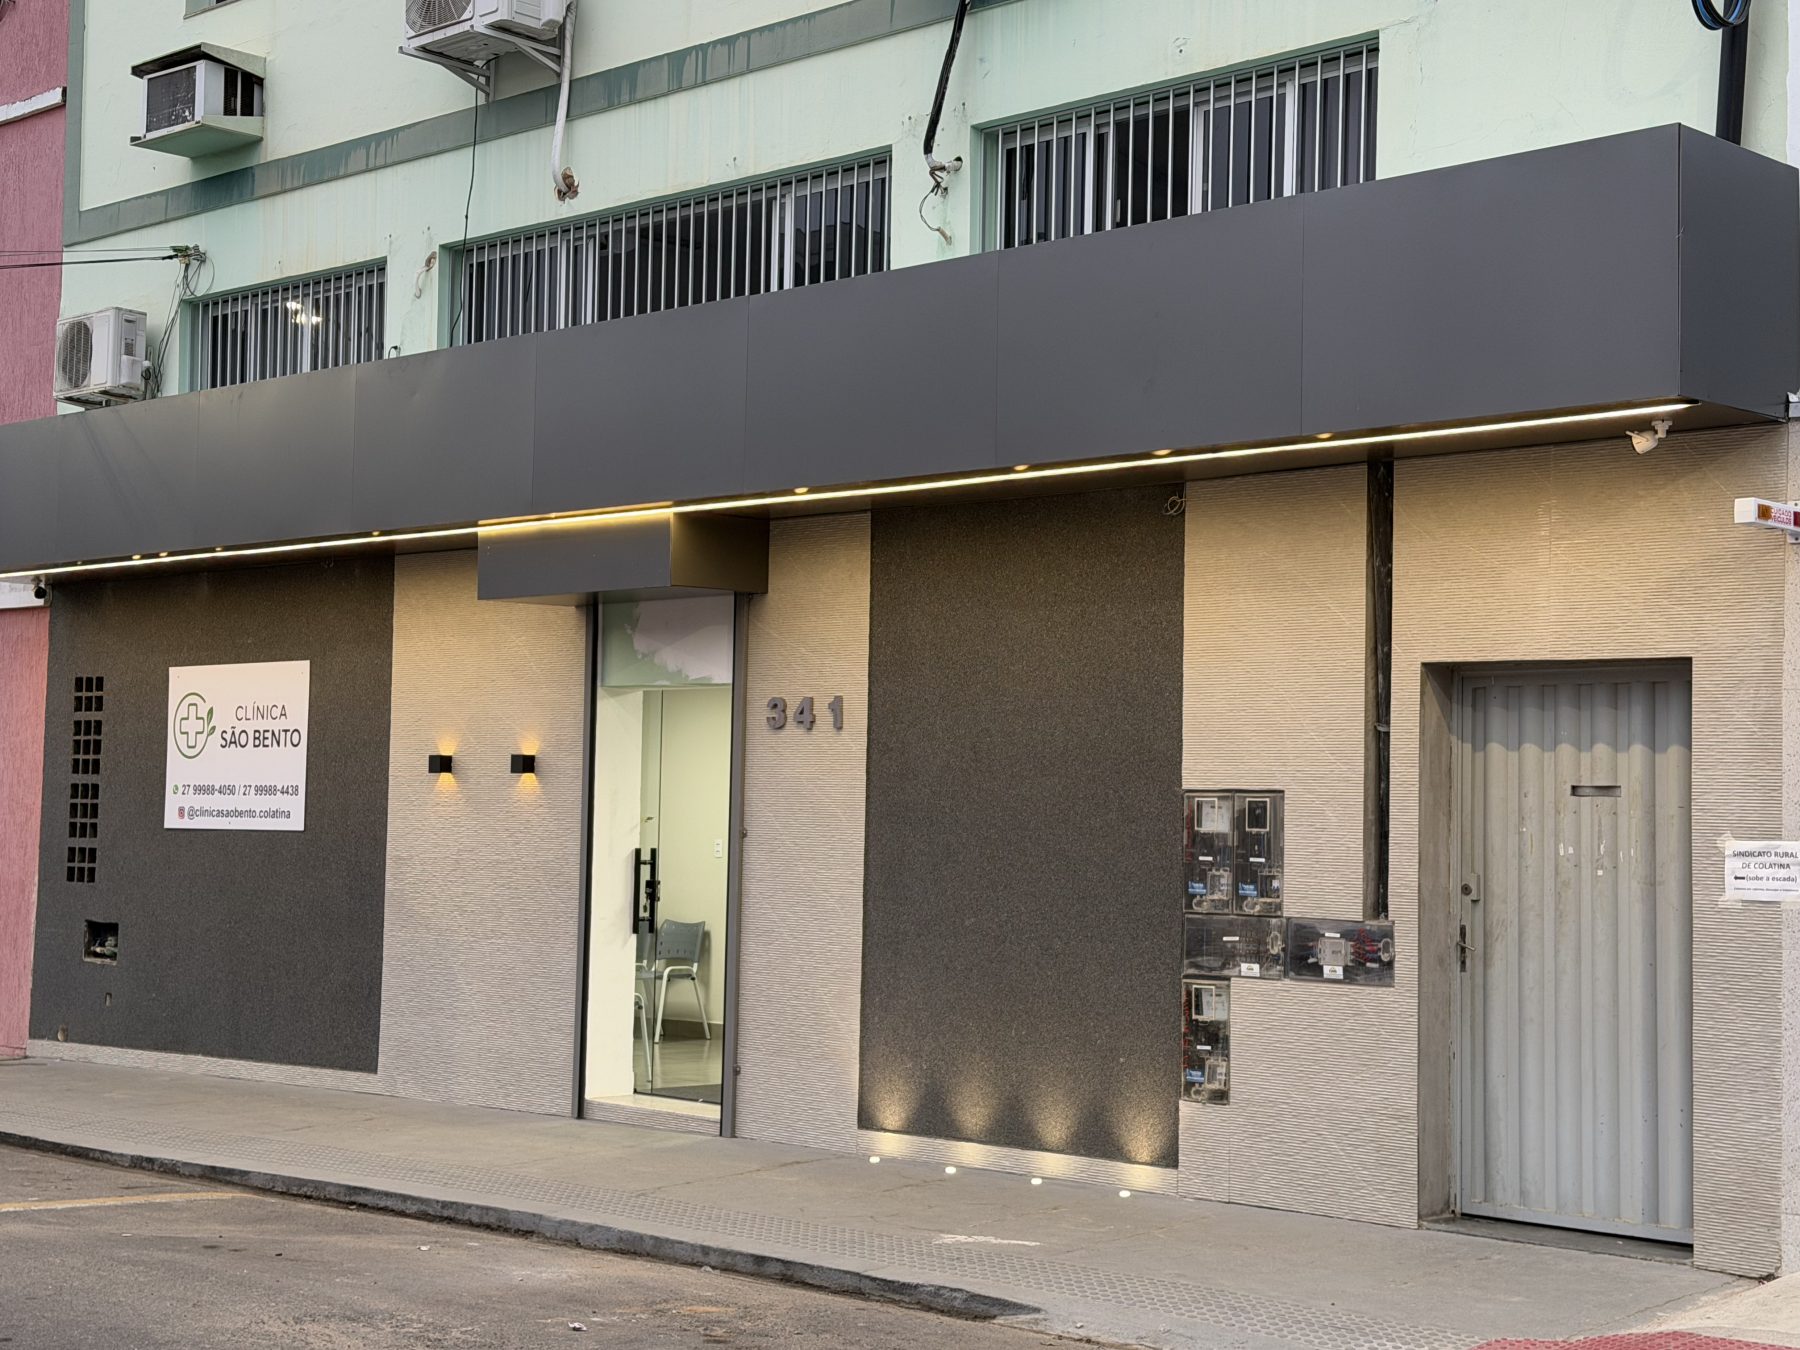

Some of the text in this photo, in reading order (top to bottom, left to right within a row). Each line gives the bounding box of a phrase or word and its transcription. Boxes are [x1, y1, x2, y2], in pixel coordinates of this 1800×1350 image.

[235, 701, 288, 721] CLÍNICA
[766, 695, 844, 730] 341
[220, 726, 302, 749] SÃO BENTO
[181, 784, 299, 797] 27 99988-4050 / 27 99988-4438
[187, 806, 291, 820] @clinicasaobento.colatina
[1746, 874, 1764, 882] (sobe
